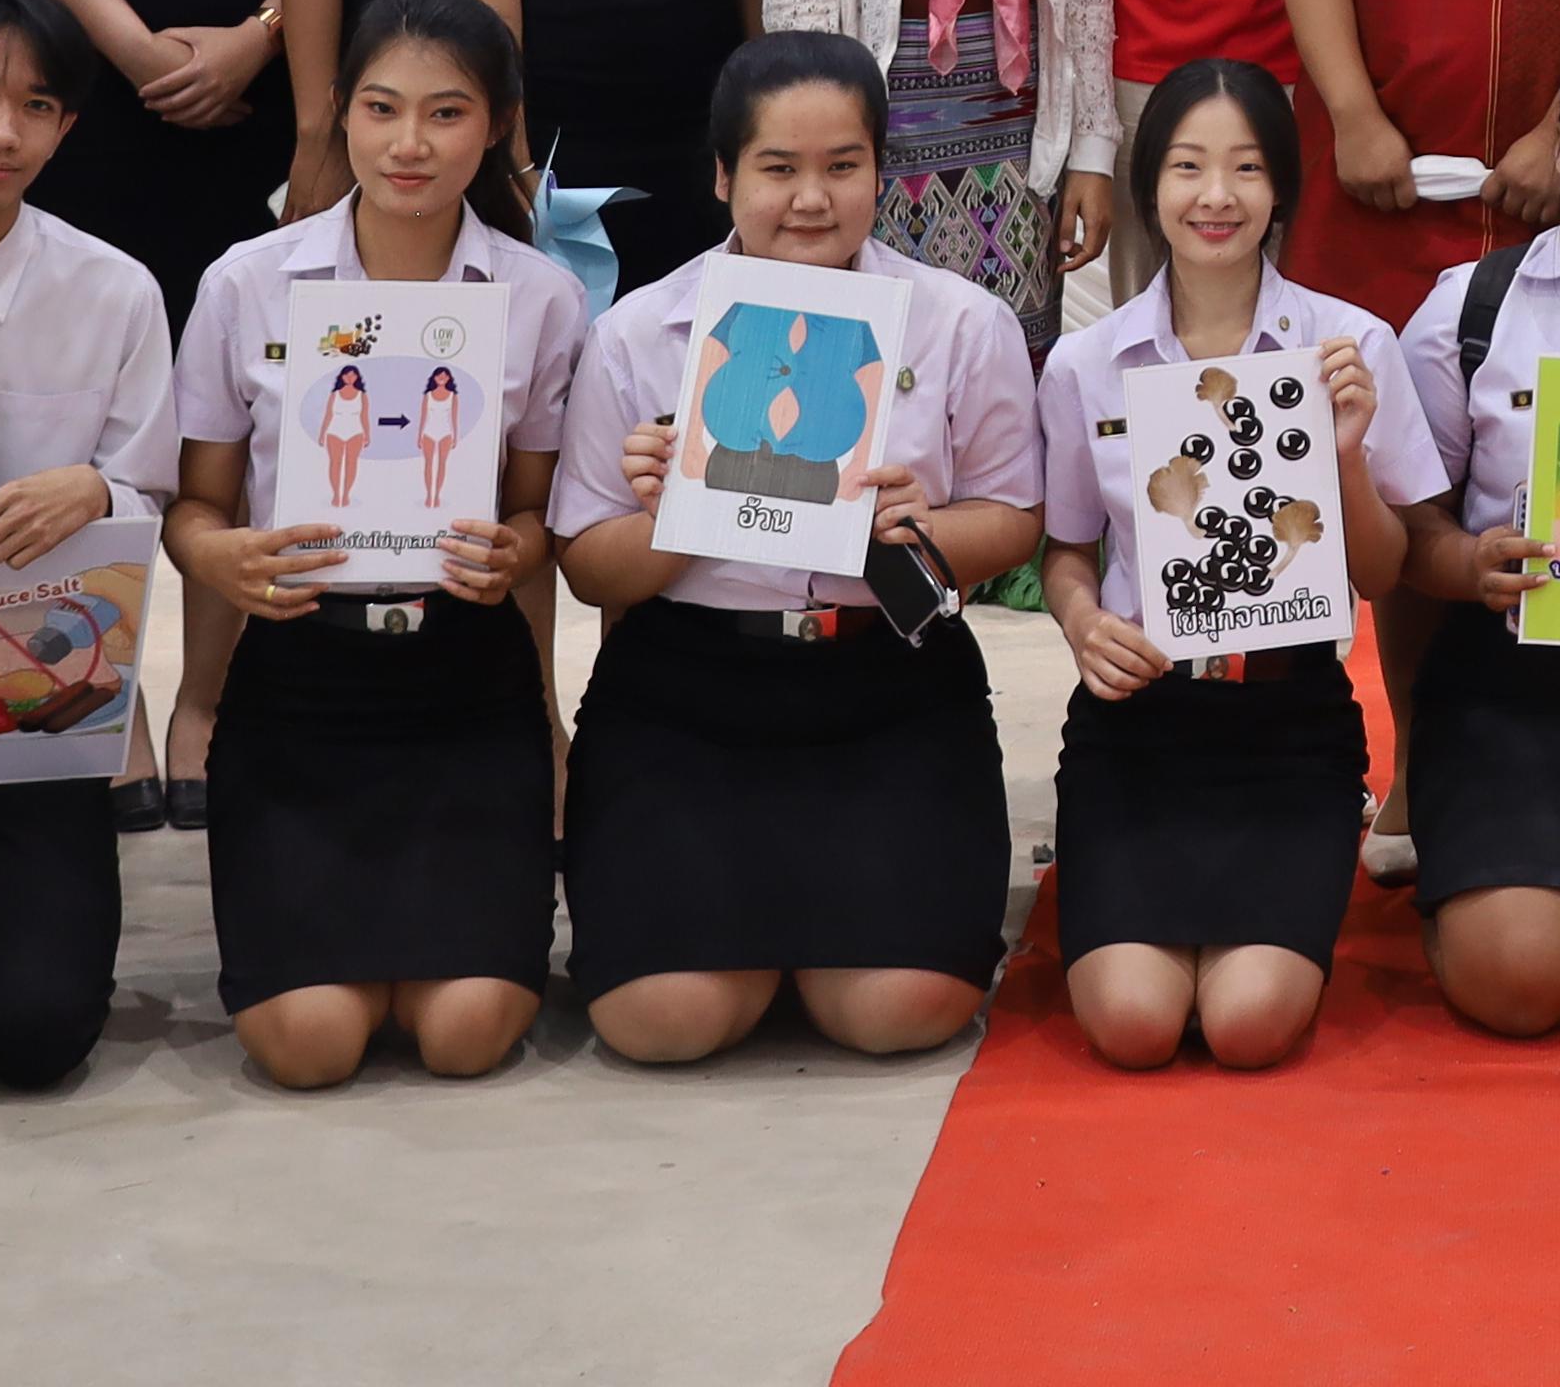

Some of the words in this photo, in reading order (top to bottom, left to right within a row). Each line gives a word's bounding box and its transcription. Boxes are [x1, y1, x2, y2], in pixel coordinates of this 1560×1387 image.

[737, 497, 792, 534] อ้วน
[36, 577, 82, 600] Salt
[1167, 587, 1331, 642] ไข่มุกจากเห็ด
